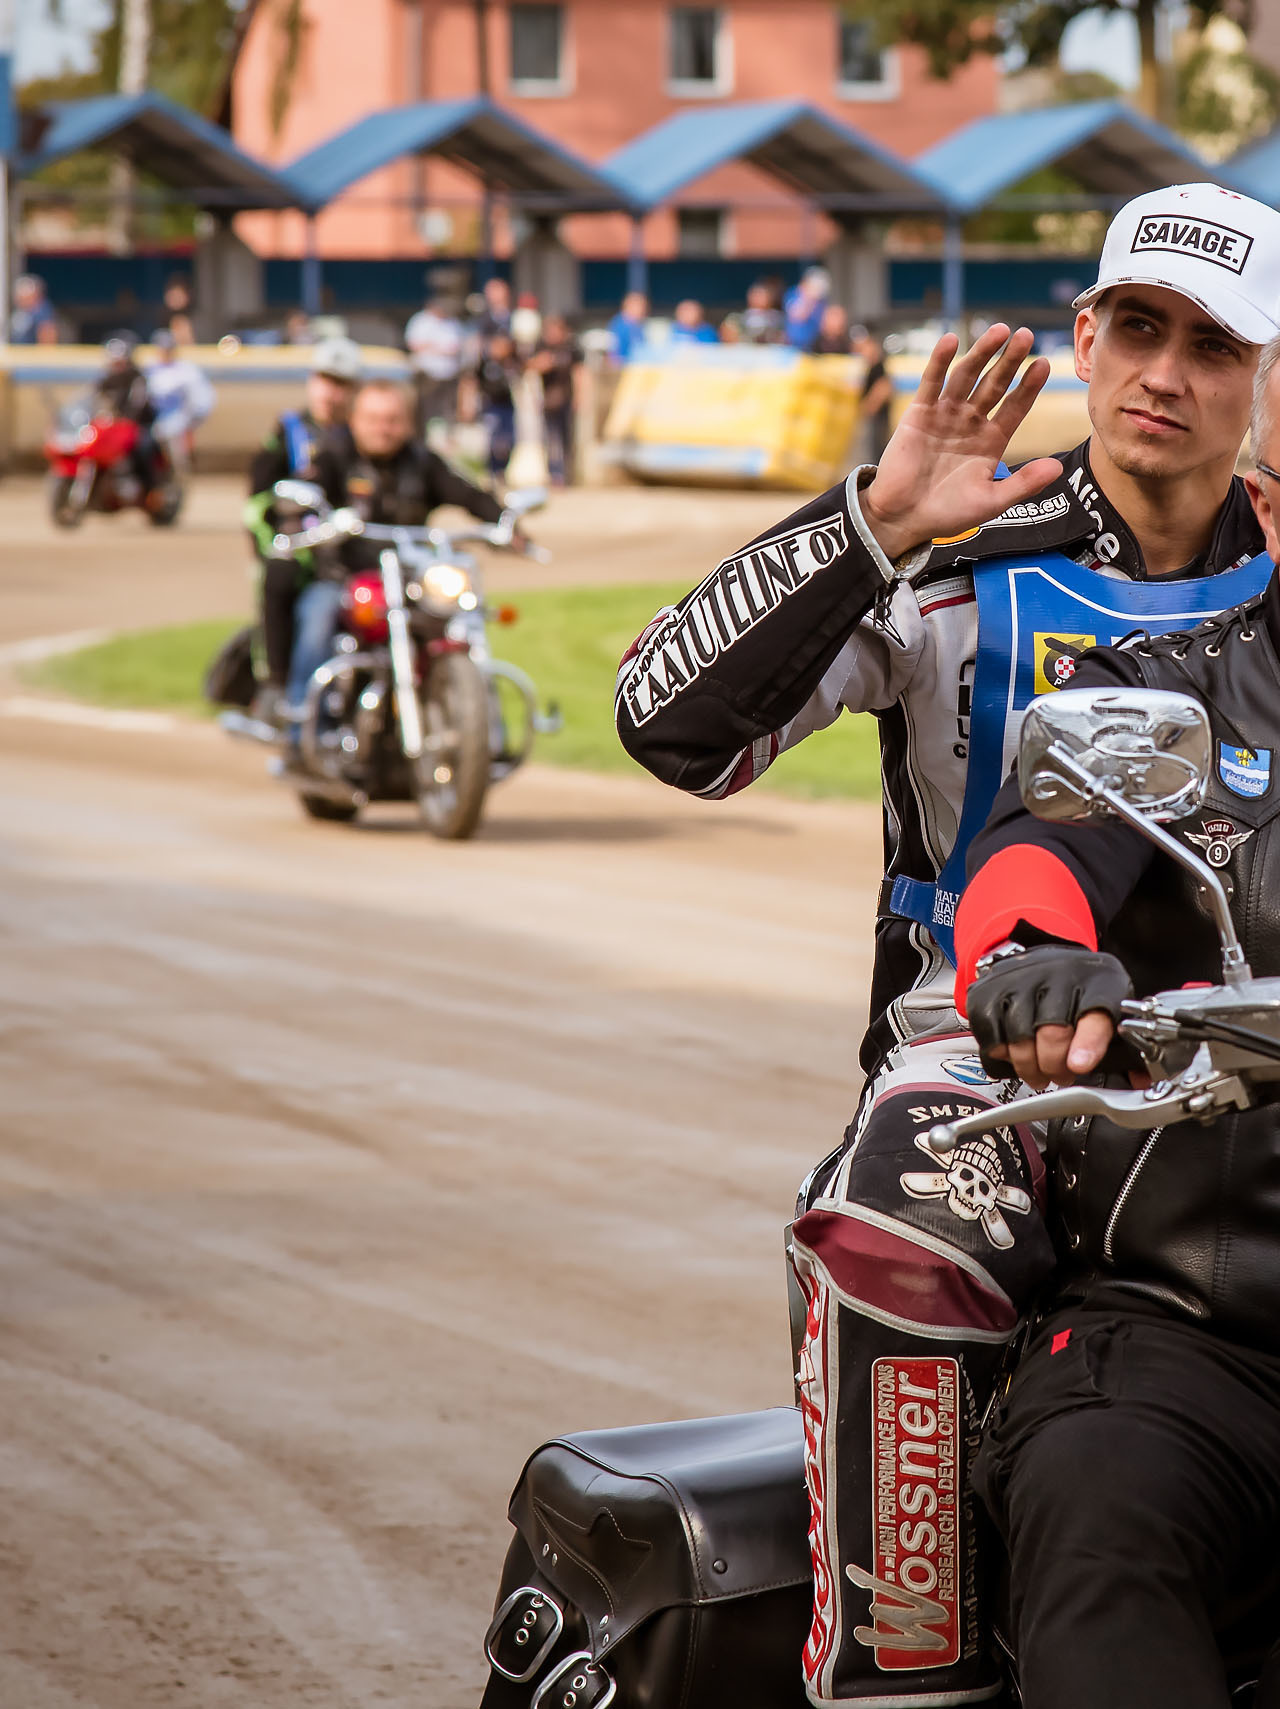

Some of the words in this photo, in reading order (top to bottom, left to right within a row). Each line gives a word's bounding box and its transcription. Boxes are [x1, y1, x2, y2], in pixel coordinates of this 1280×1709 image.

[1140, 222, 1239, 264] SAVAGE.
[629, 538, 810, 722] LAATUTELINE
[809, 522, 846, 566] OY
[1214, 846, 1222, 861] 9
[877, 1364, 896, 1420] PISTONS
[936, 1365, 954, 1490] DEVELOPMENT
[877, 1421, 897, 1525] PERFORMANCE
[938, 1493, 955, 1506] &
[878, 1526, 897, 1558] HIGH
[938, 1510, 955, 1602] RESEARCH
